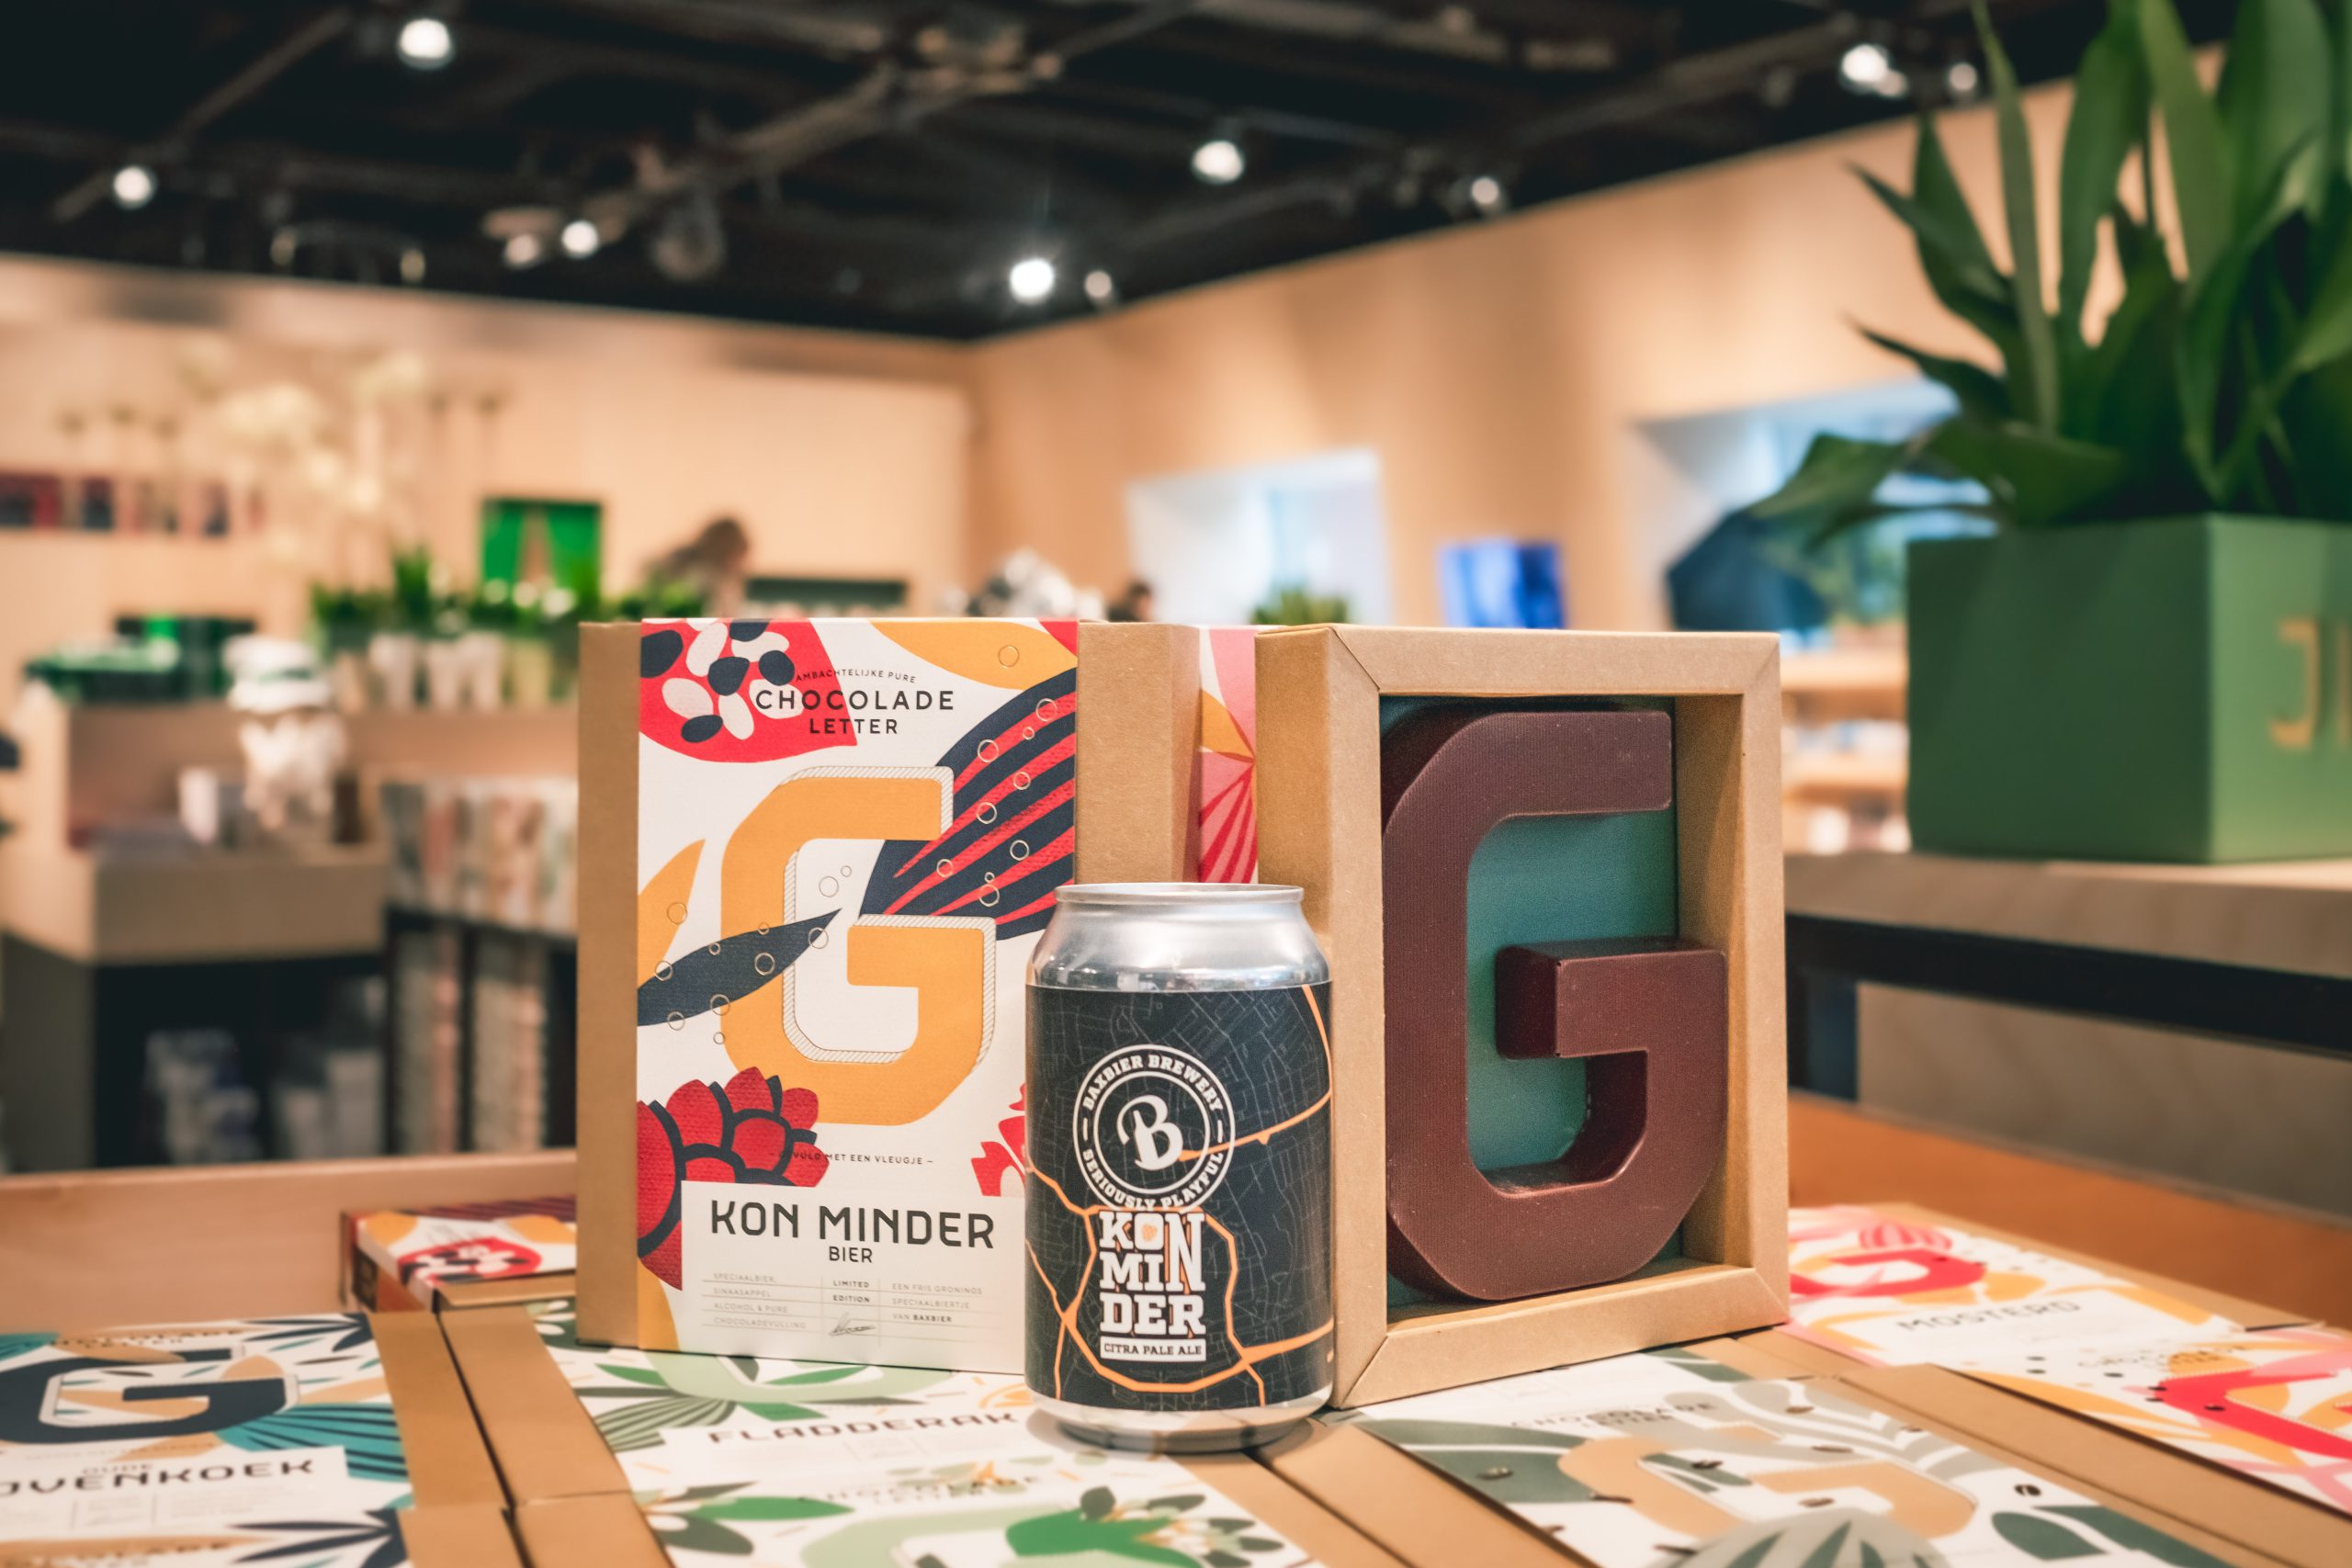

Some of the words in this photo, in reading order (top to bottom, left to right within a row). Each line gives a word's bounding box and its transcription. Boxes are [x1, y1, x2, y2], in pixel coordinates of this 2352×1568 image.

[796, 669, 884, 682] AMBACHTELIJKE
[888, 671, 916, 683] PURE
[755, 690, 954, 710] CHOCOLADE
[809, 718, 898, 734] LETTER
[1082, 1055, 1144, 1111] BAXBIER
[1148, 1055, 1223, 1111] BREWERY
[825, 1153, 845, 1162] MET
[850, 1155, 871, 1163] EEN
[875, 1156, 922, 1165] VLEUGJE
[1083, 1149, 1156, 1211] SERIOUSLY
[1160, 1152, 1224, 1210] PLAYFUL
[711, 1200, 798, 1238] KON
[819, 1205, 993, 1249] MINDER
[829, 1246, 873, 1264] BIER
[832, 1280, 869, 1288] LIMITED
[832, 1294, 870, 1303] EDITION
[912, 1314, 952, 1323] BAXBIER
[1897, 1301, 2081, 1332] MOSTERD
[1104, 1343, 1138, 1355] CITRA
[1143, 1346, 1173, 1355] PALE
[1178, 1346, 1201, 1355] ALE
[708, 1413, 1018, 1443] FLADDERAK
